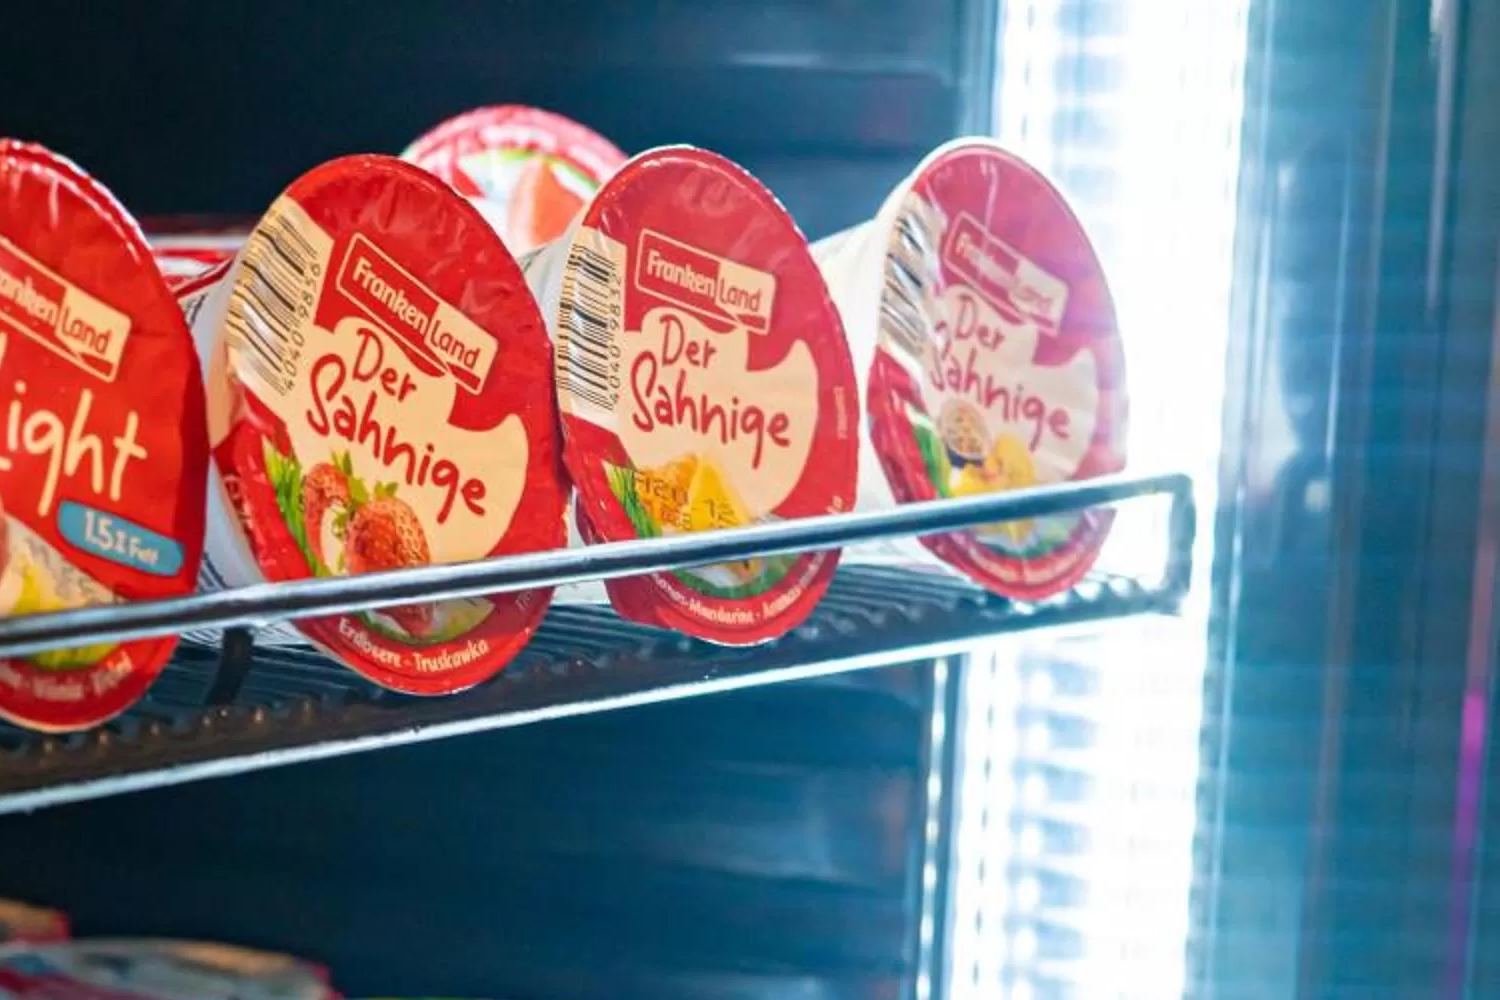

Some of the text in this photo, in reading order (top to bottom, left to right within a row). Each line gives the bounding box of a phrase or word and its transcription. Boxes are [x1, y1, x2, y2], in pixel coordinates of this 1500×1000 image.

[352, 328, 417, 402] Der
[659, 314, 717, 369] Der
[955, 294, 1005, 352] Der
[630, 351, 791, 470] Sahnige
[930, 320, 1070, 450] Sahnige
[305, 353, 487, 524] Sahnige
